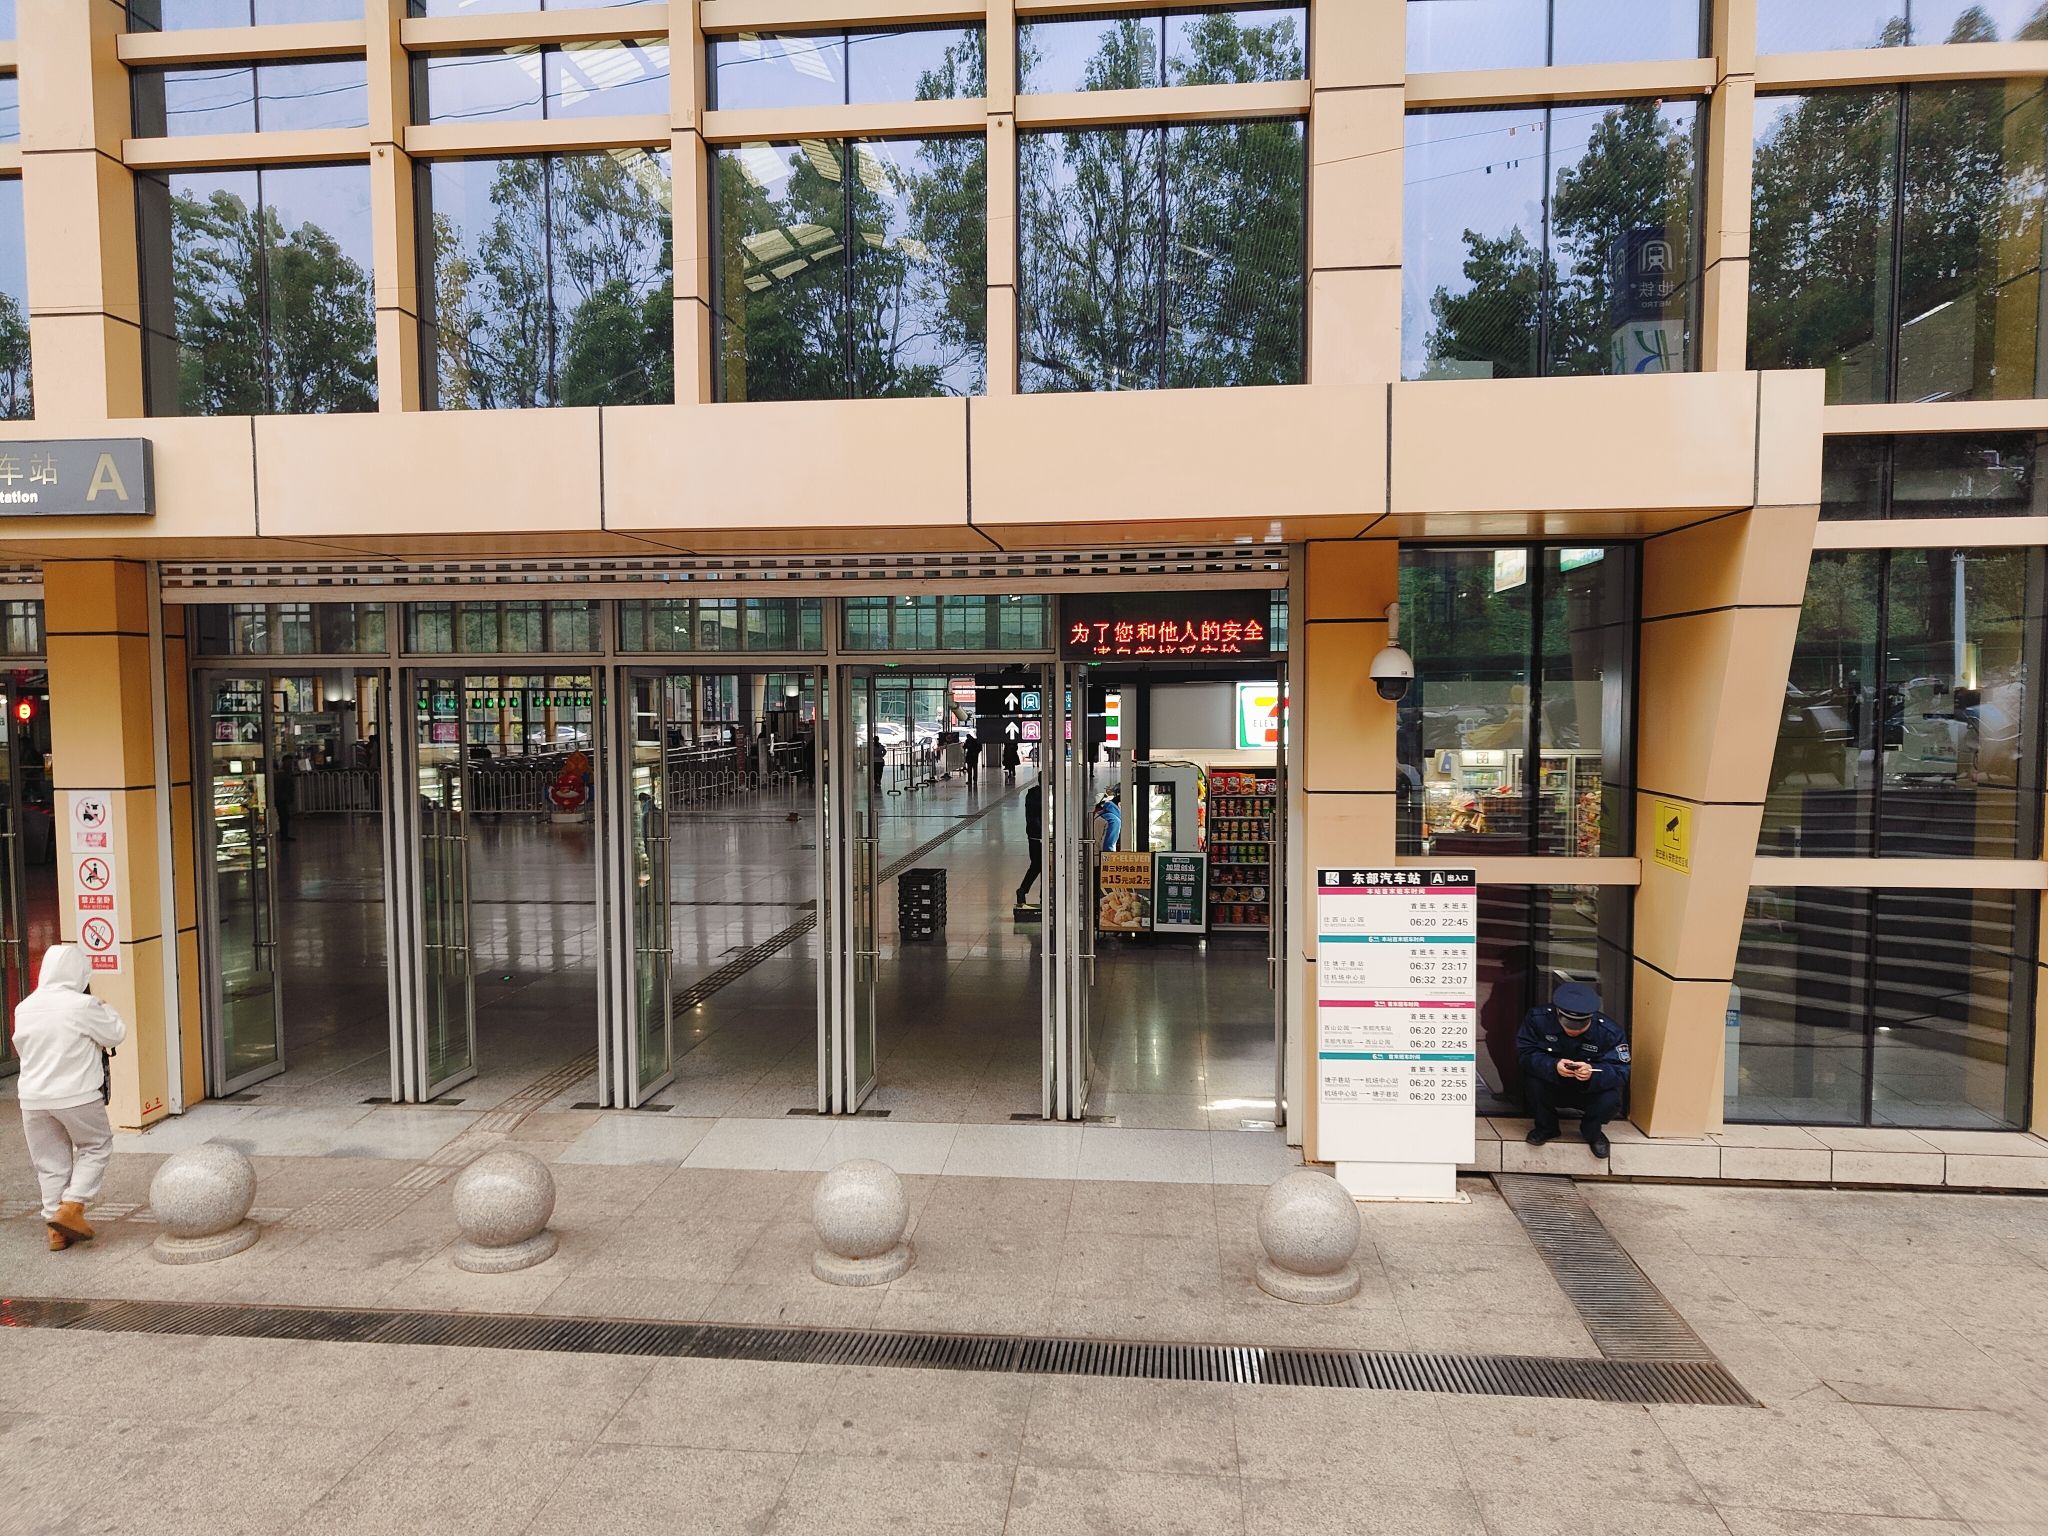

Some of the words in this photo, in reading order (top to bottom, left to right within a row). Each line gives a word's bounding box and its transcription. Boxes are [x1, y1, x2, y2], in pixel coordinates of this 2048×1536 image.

[86, 452, 129, 502] A
[1070, 620, 1264, 644] 为了您和他人的安全
[1352, 872, 1421, 885] 东部汽车站
[1432, 873, 1443, 884] A
[1447, 874, 1469, 882] 出入口
[1410, 918, 1436, 927] 06:20
[1442, 918, 1469, 927] 22:45
[1410, 962, 1435, 971] 06:37
[1441, 962, 1468, 971] 23:17
[1410, 976, 1435, 984] 06:32
[1441, 976, 1468, 984] 23:07
[1410, 1026, 1435, 1035] 06:20
[1441, 1026, 1468, 1035] 22:20
[1410, 1040, 1435, 1048] 06:20
[1441, 1040, 1468, 1049] 22:45
[1409, 1079, 1435, 1087] 06:20
[1441, 1079, 1468, 1087] 22:55
[1409, 1092, 1435, 1101] 06:20
[1441, 1092, 1468, 1101] 23:00
